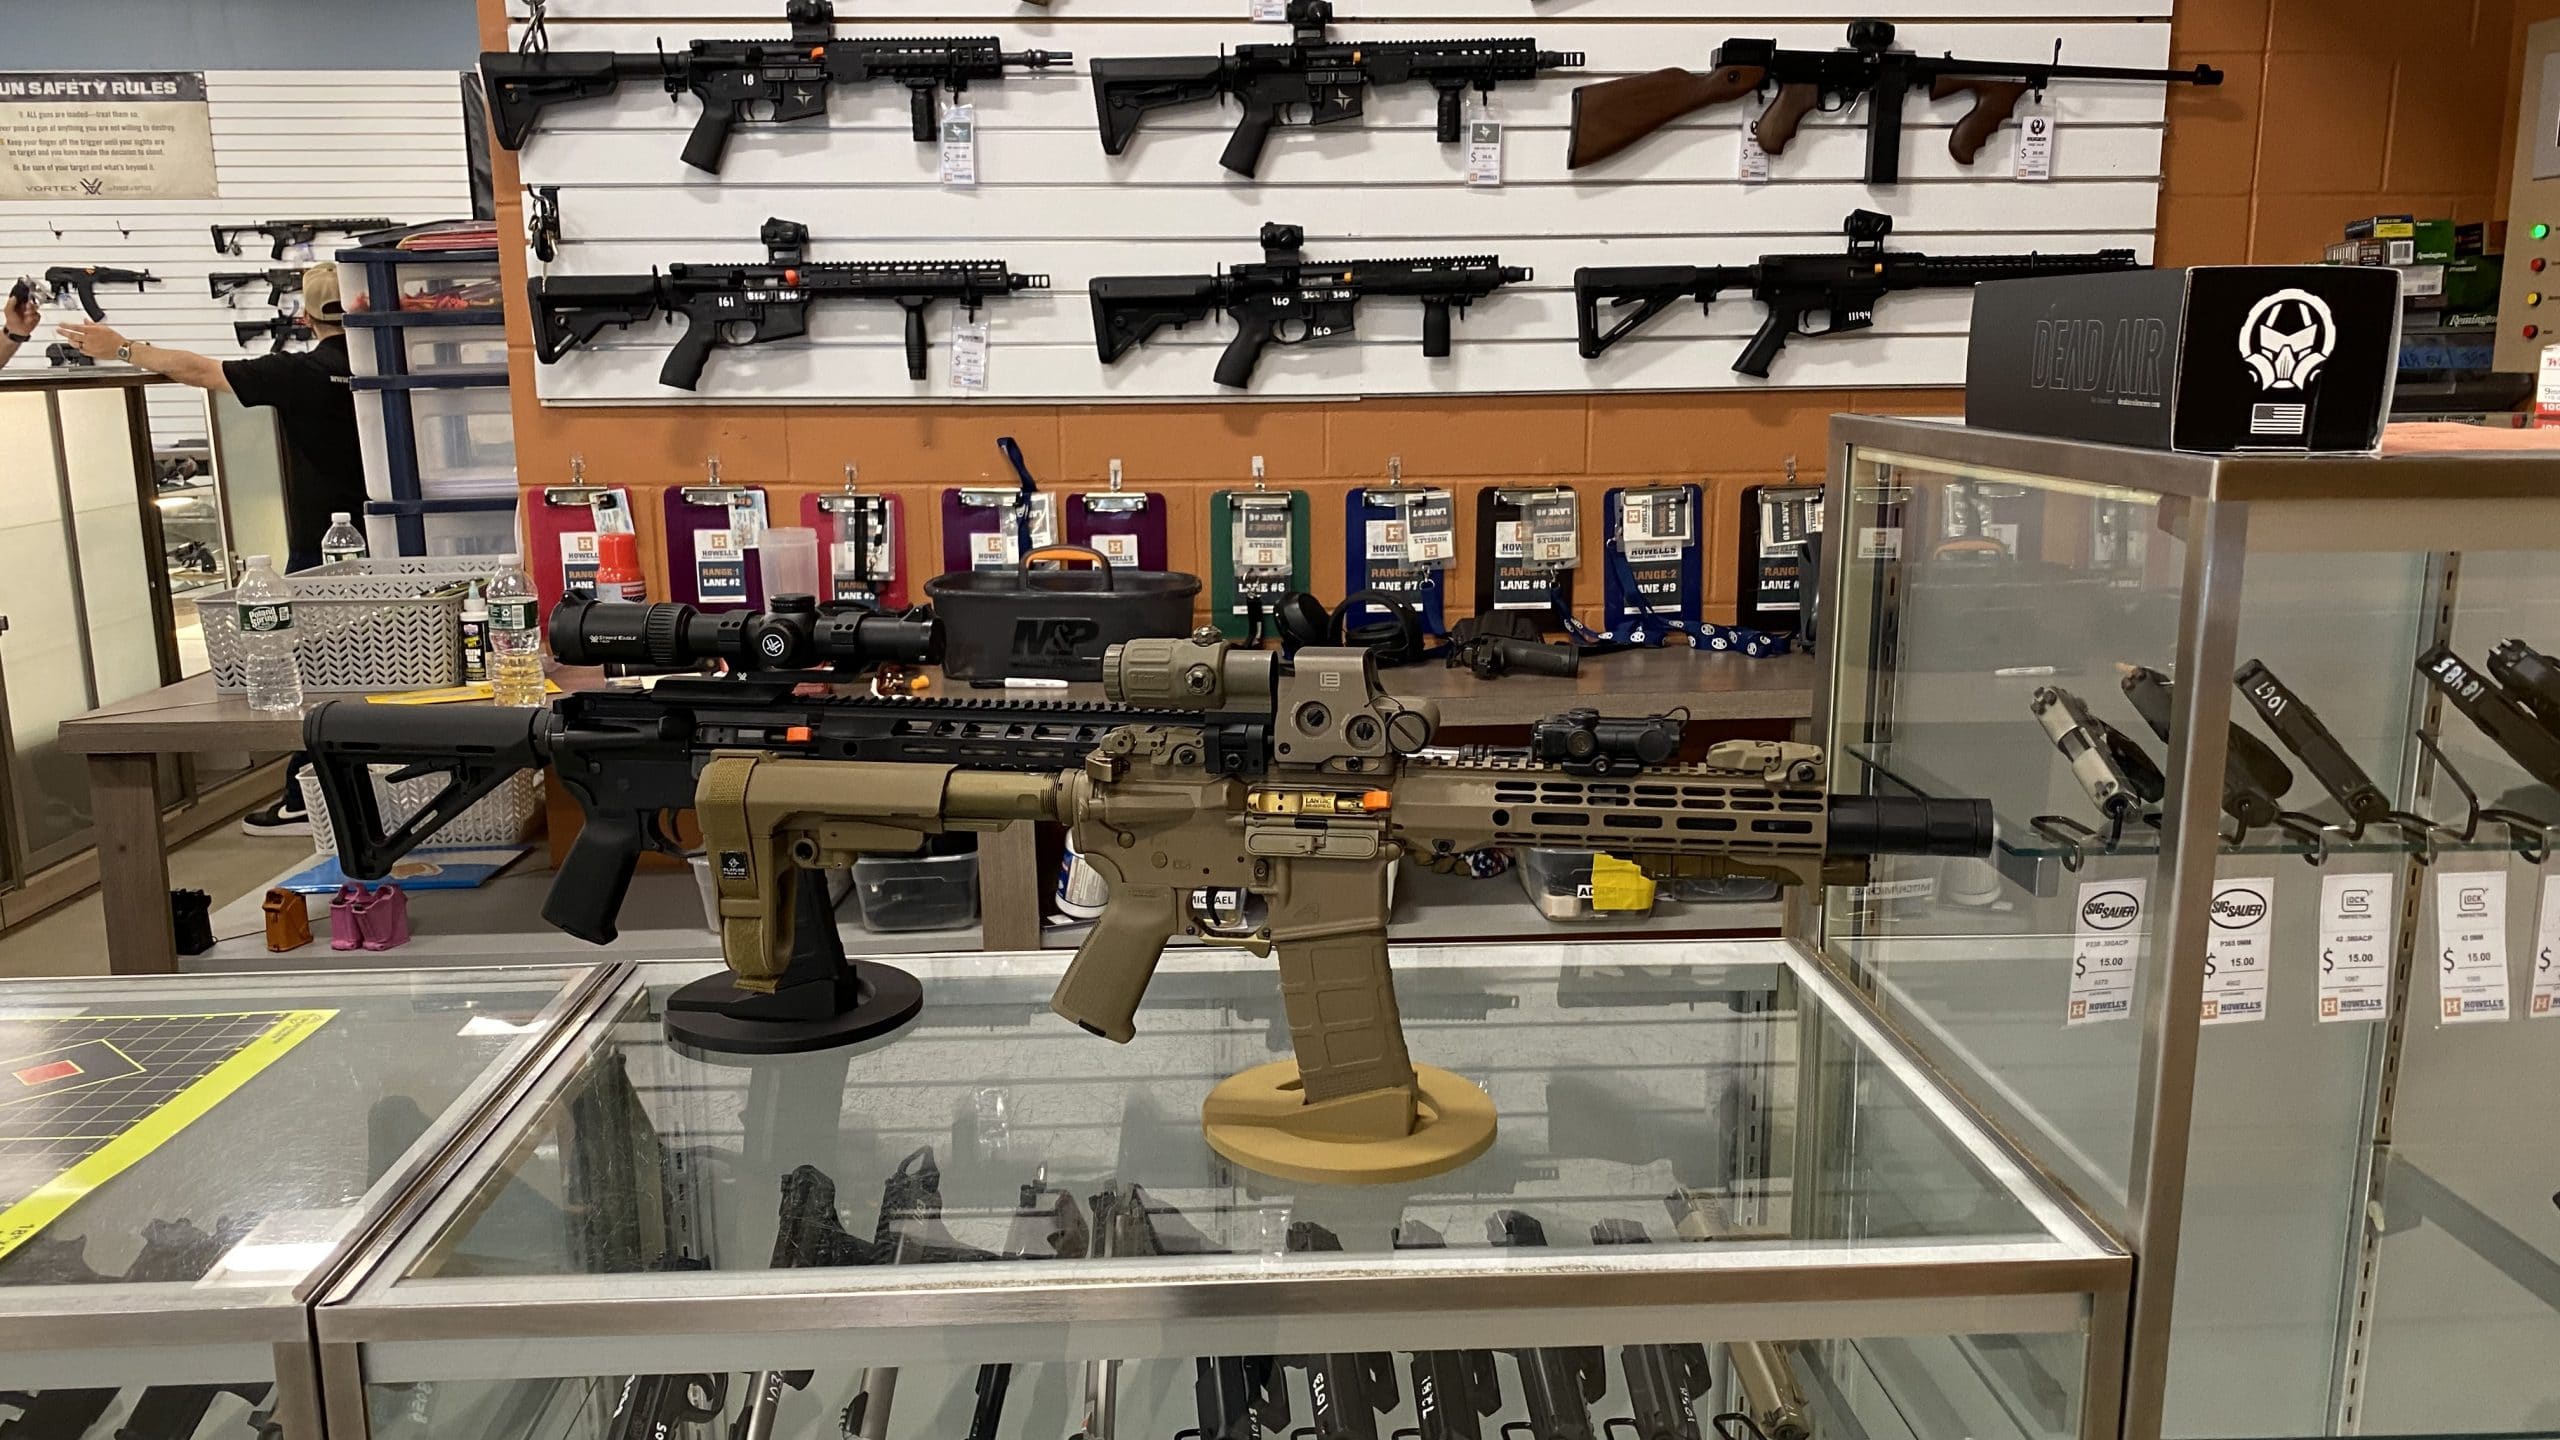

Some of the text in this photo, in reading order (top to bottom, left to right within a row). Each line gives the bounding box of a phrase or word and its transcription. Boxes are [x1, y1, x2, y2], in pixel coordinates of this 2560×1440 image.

[742, 73, 754, 86] 18
[28, 82, 107, 95] SAFETY
[111, 82, 177, 95] RULES
[718, 296, 734, 307] 161
[1312, 327, 1331, 336] 160
[2032, 318, 2167, 396] DEAD AIR
[1412, 508, 1447, 518] LANE #7
[1668, 510, 1676, 533] LANE
[570, 581, 595, 589] LANE
[703, 579, 741, 587] LANE #2
[1270, 583, 1286, 593] #6
[1371, 581, 1418, 591] LANE #7
[1500, 580, 1547, 590] LANE #8
[1662, 582, 1677, 592] #9
[1761, 580, 1790, 590] LANE
[838, 591, 862, 600] LANE
[1011, 617, 1100, 656] M&P
[2255, 682, 2288, 717] 1067
[1193, 896, 1234, 904] ICAEL
[2086, 902, 2136, 919] SIG SAUER
[2212, 900, 2263, 917] SIG SAUER
[2323, 948, 2373, 974] $ 15.00
[2443, 947, 2491, 974] $ 15.00
[2539, 946, 2551, 972] $
[2075, 953, 2123, 979] $ 15.00
[2204, 952, 2254, 979] $ 15.00
[2089, 1000, 2127, 1010] HOWELL'S
[2221, 1001, 2261, 1011] HOWELL'S
[2341, 999, 2382, 1008] HOWELL'S
[2464, 999, 2504, 1008] HOWELL'S
[1313, 1372, 1328, 1415] 1073
